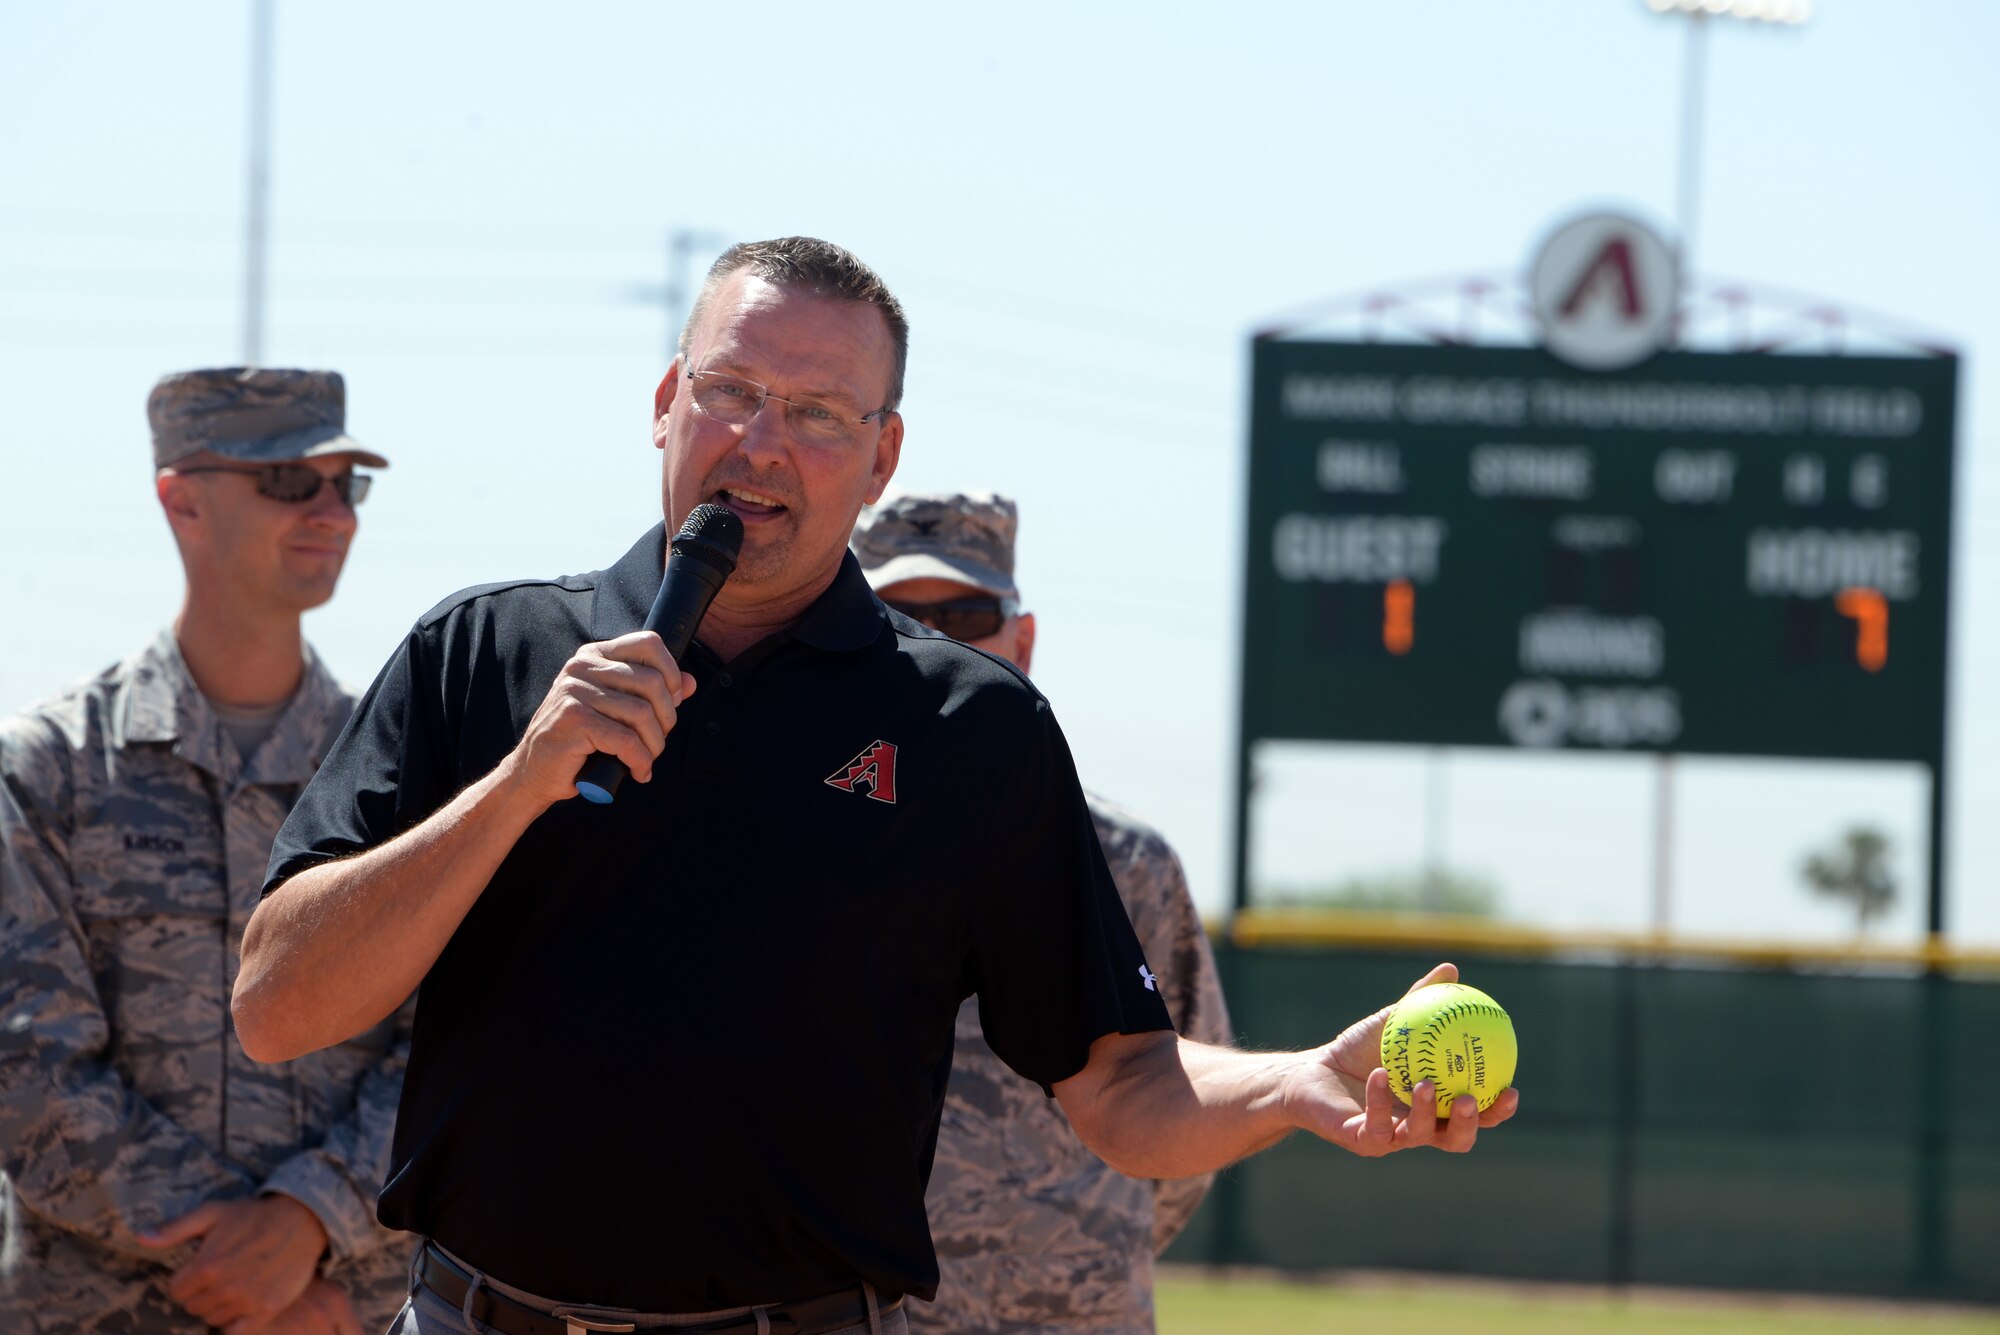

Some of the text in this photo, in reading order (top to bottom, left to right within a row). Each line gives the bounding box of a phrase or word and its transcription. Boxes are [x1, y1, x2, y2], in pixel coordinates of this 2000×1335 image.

[1318, 441, 1403, 491] BALL
[1470, 445, 1593, 496] STRIKE
[1656, 451, 1737, 502] OUT
[1273, 515, 1446, 581] GUEST
[1747, 529, 1920, 598] HOME
[1393, 1038, 1412, 1086] TATTOO
